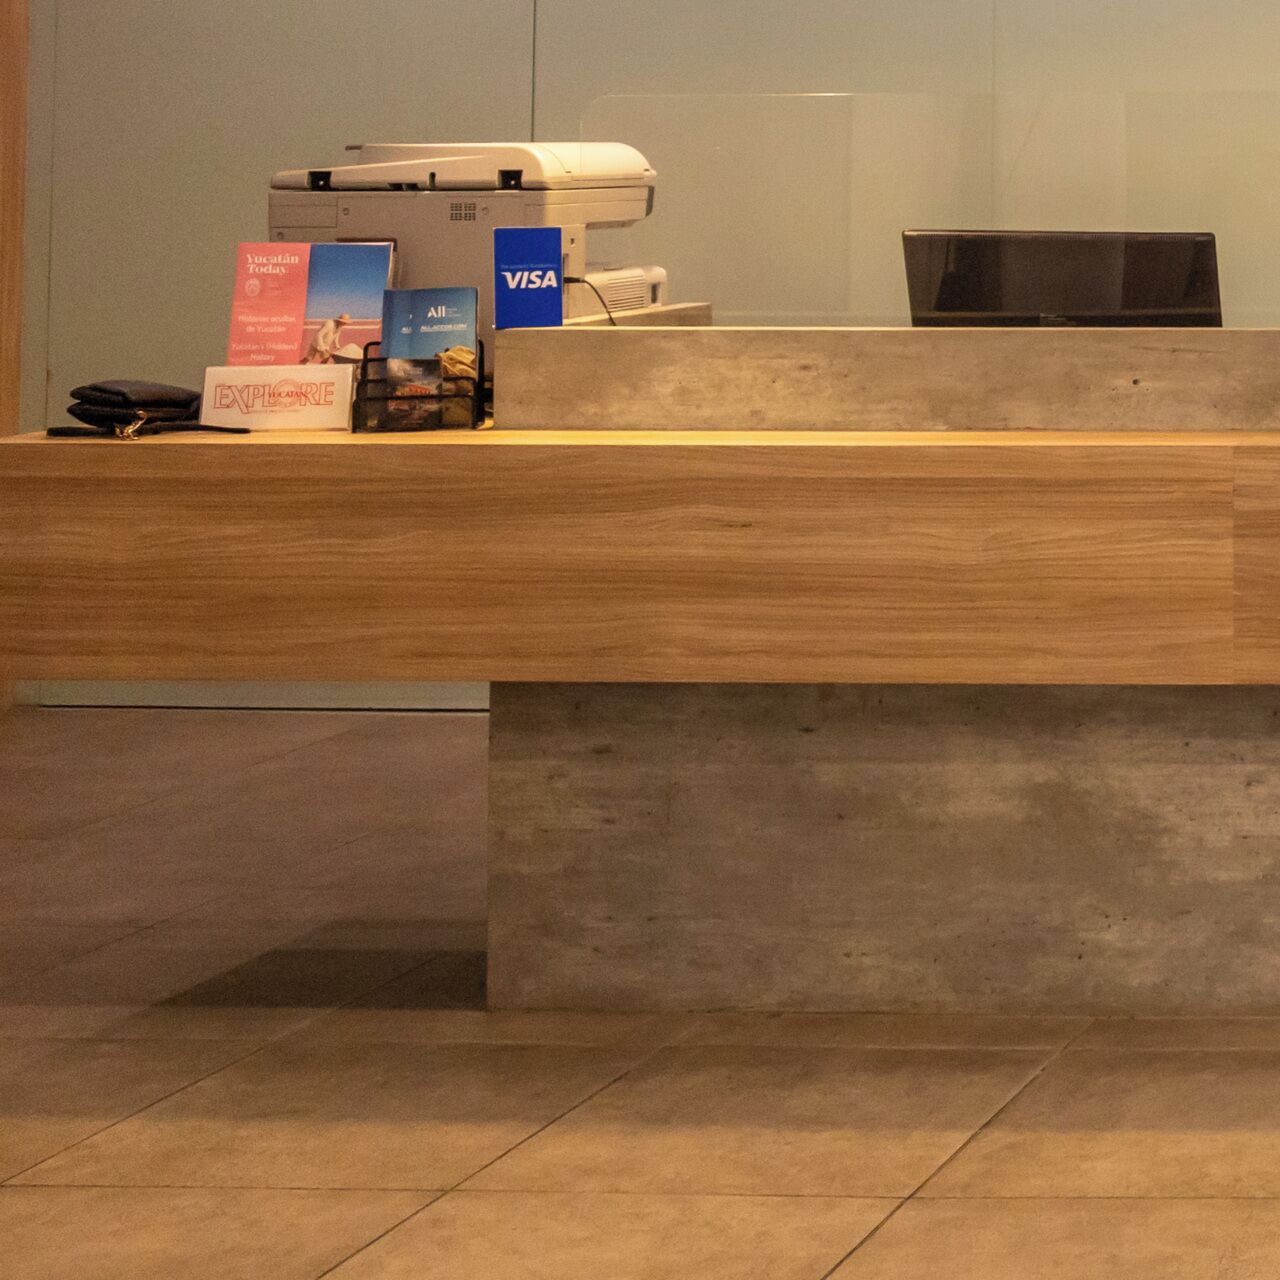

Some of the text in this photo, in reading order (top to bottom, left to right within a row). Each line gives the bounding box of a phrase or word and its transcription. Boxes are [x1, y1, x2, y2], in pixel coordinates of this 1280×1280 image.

[246, 253, 299, 264] Yucatán
[248, 265, 286, 275] Today
[501, 270, 558, 289] VISA
[213, 378, 336, 414] EXPLORE
